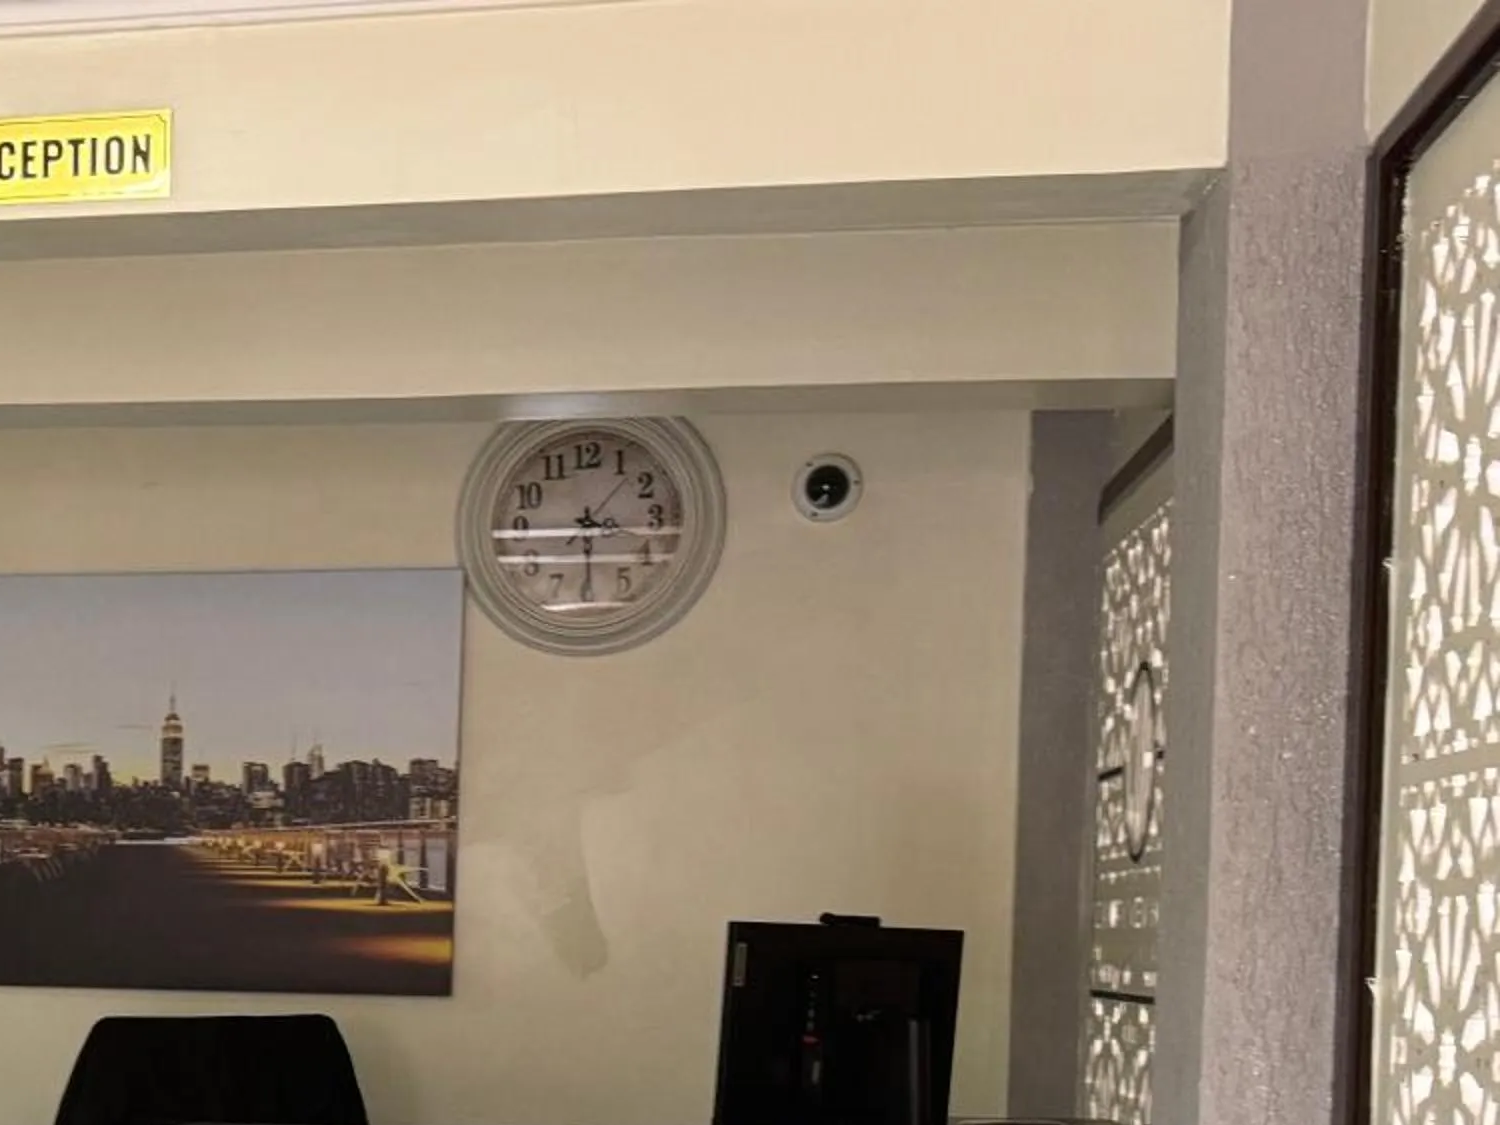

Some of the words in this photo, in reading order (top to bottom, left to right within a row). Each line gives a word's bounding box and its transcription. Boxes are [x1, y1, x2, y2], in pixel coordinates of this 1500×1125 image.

[543, 454, 567, 481] 11
[573, 442, 602, 470] 12
[612, 450, 626, 476] 1
[516, 481, 544, 510] 10
[637, 472, 655, 499] 2
[647, 504, 664, 531] 3
[549, 573, 565, 599] 7
[616, 567, 633, 594] 5
